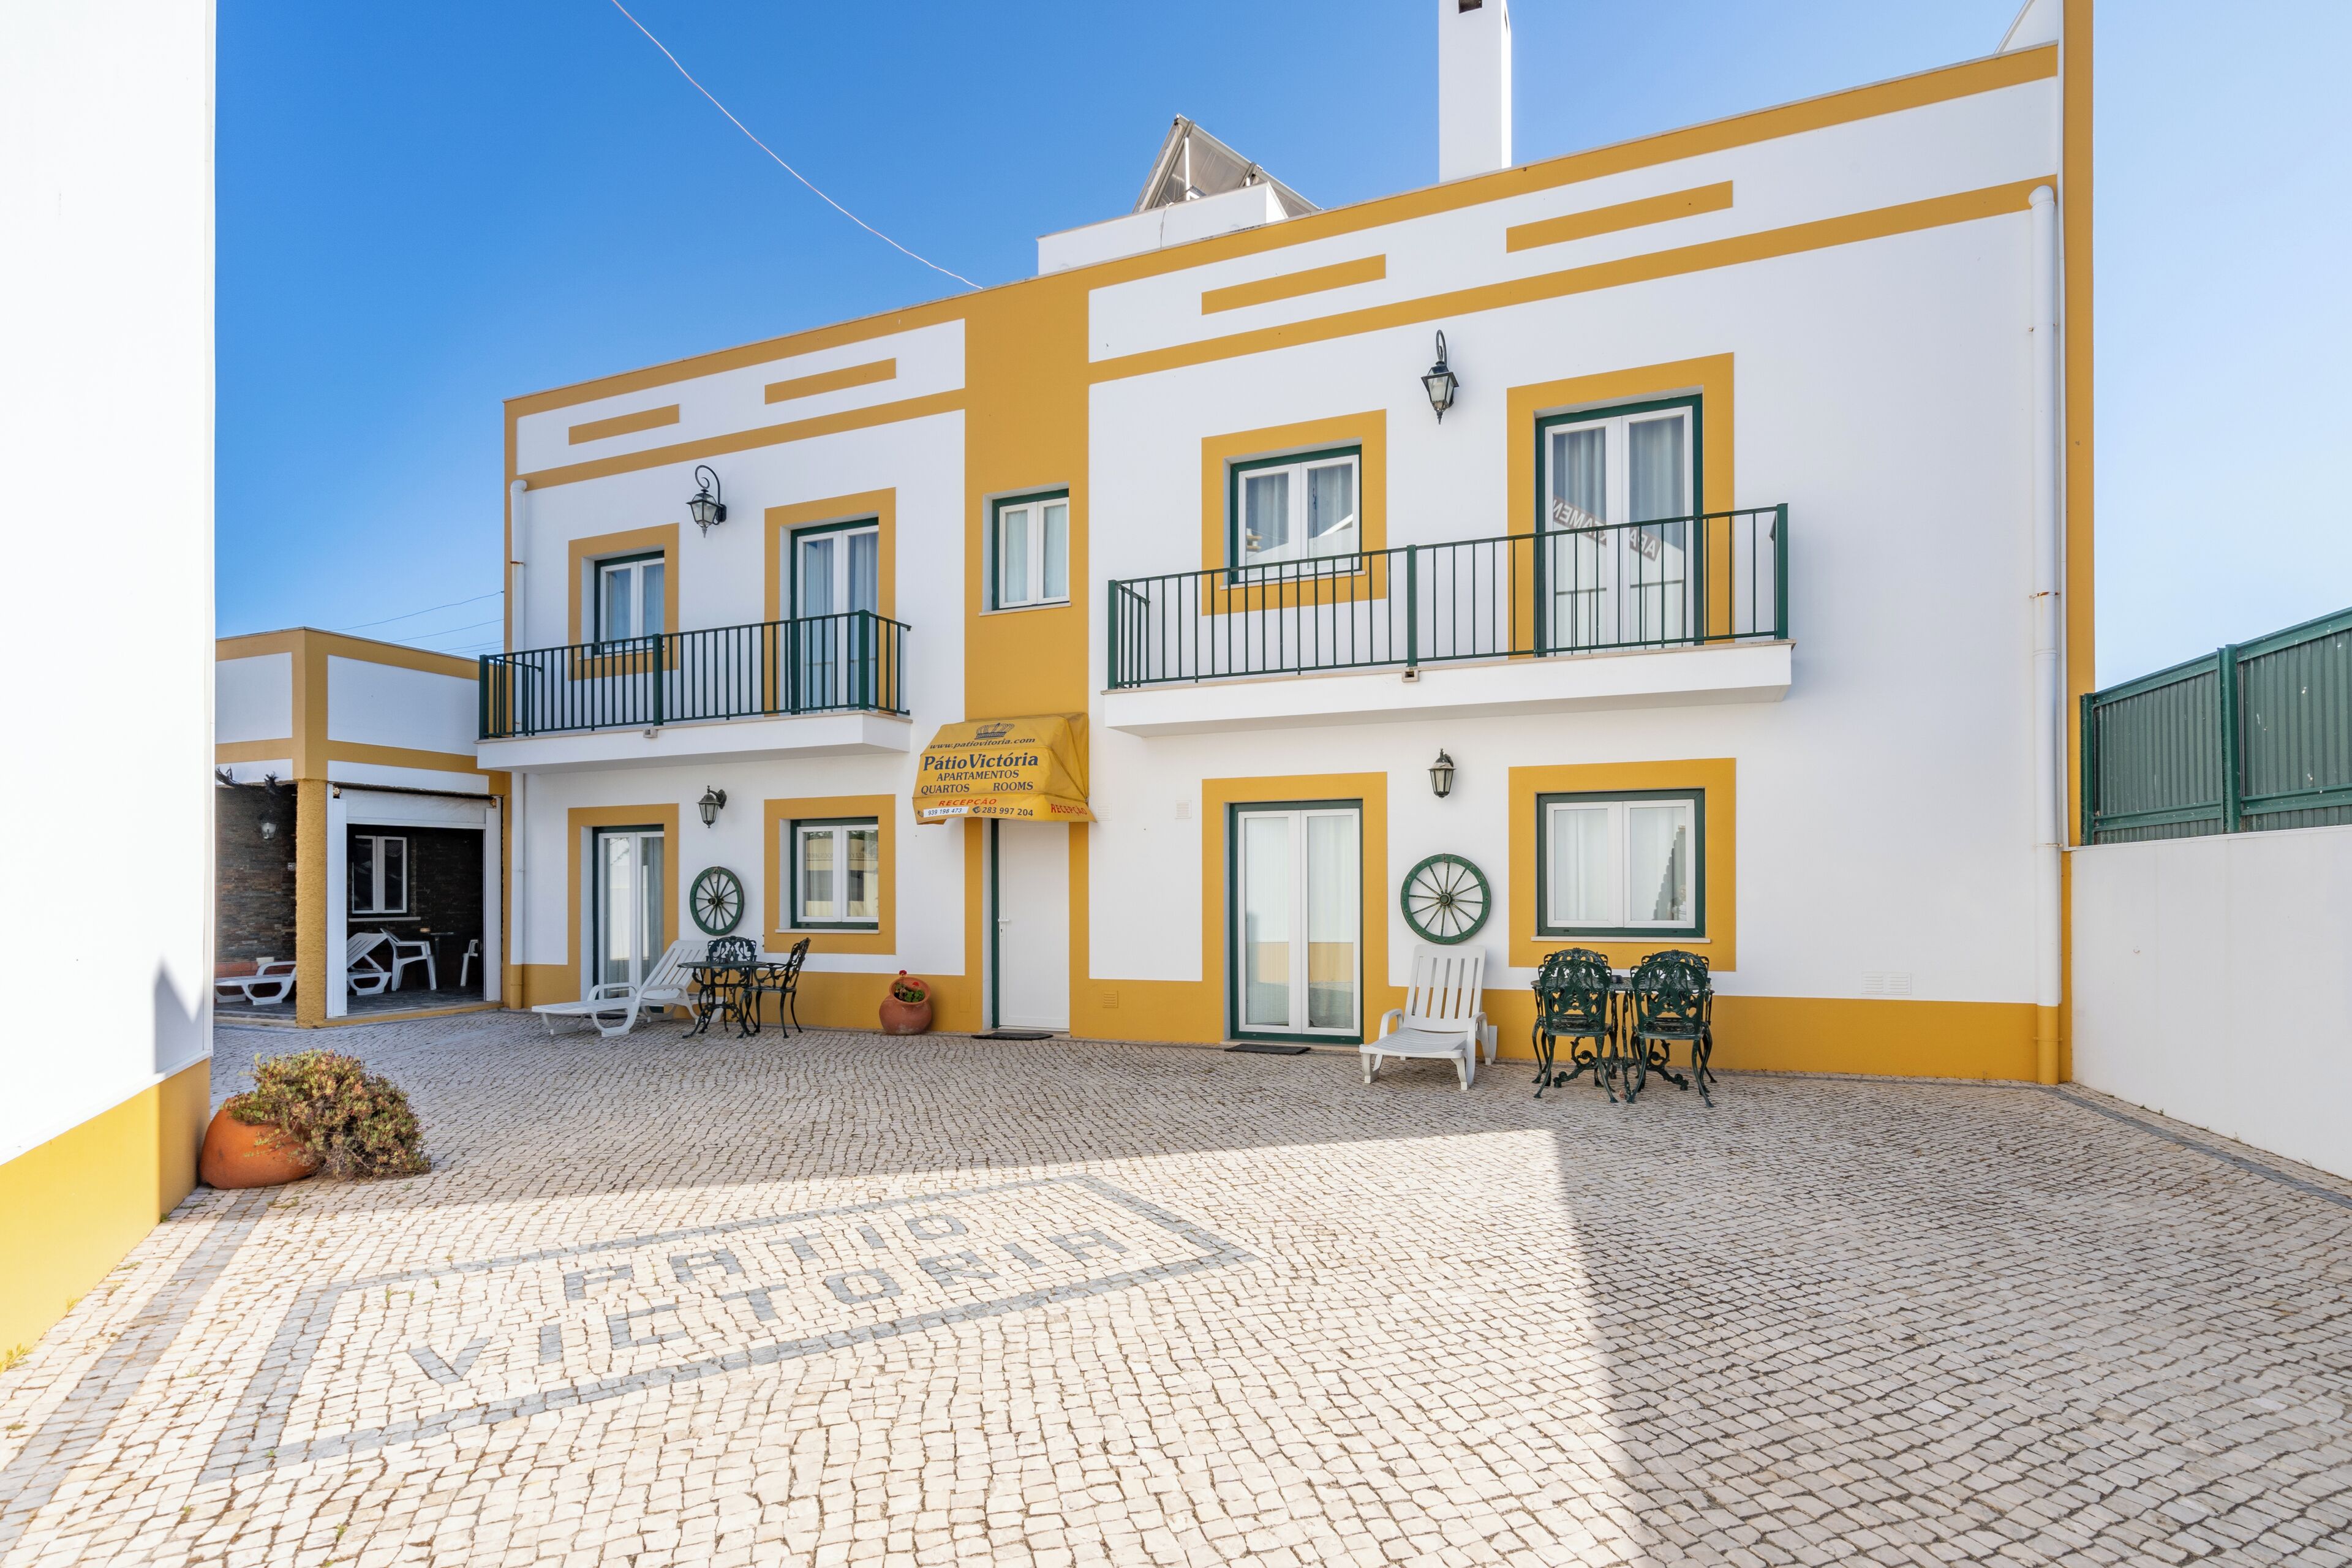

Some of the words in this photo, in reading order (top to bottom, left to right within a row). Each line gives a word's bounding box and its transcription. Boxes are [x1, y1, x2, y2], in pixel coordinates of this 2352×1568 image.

[930, 737, 1035, 749] www.patiovitoria.com
[937, 769, 1019, 782] APARTAMENTOS
[921, 783, 970, 795] QUARTOS
[993, 782, 1033, 791] ROOMS
[938, 798, 997, 807] RECEPÇÃO
[1050, 804, 1088, 816] RECEPÇÃO
[564, 1215, 969, 1301] PATIO
[409, 1229, 1128, 1385] VICTORIA
